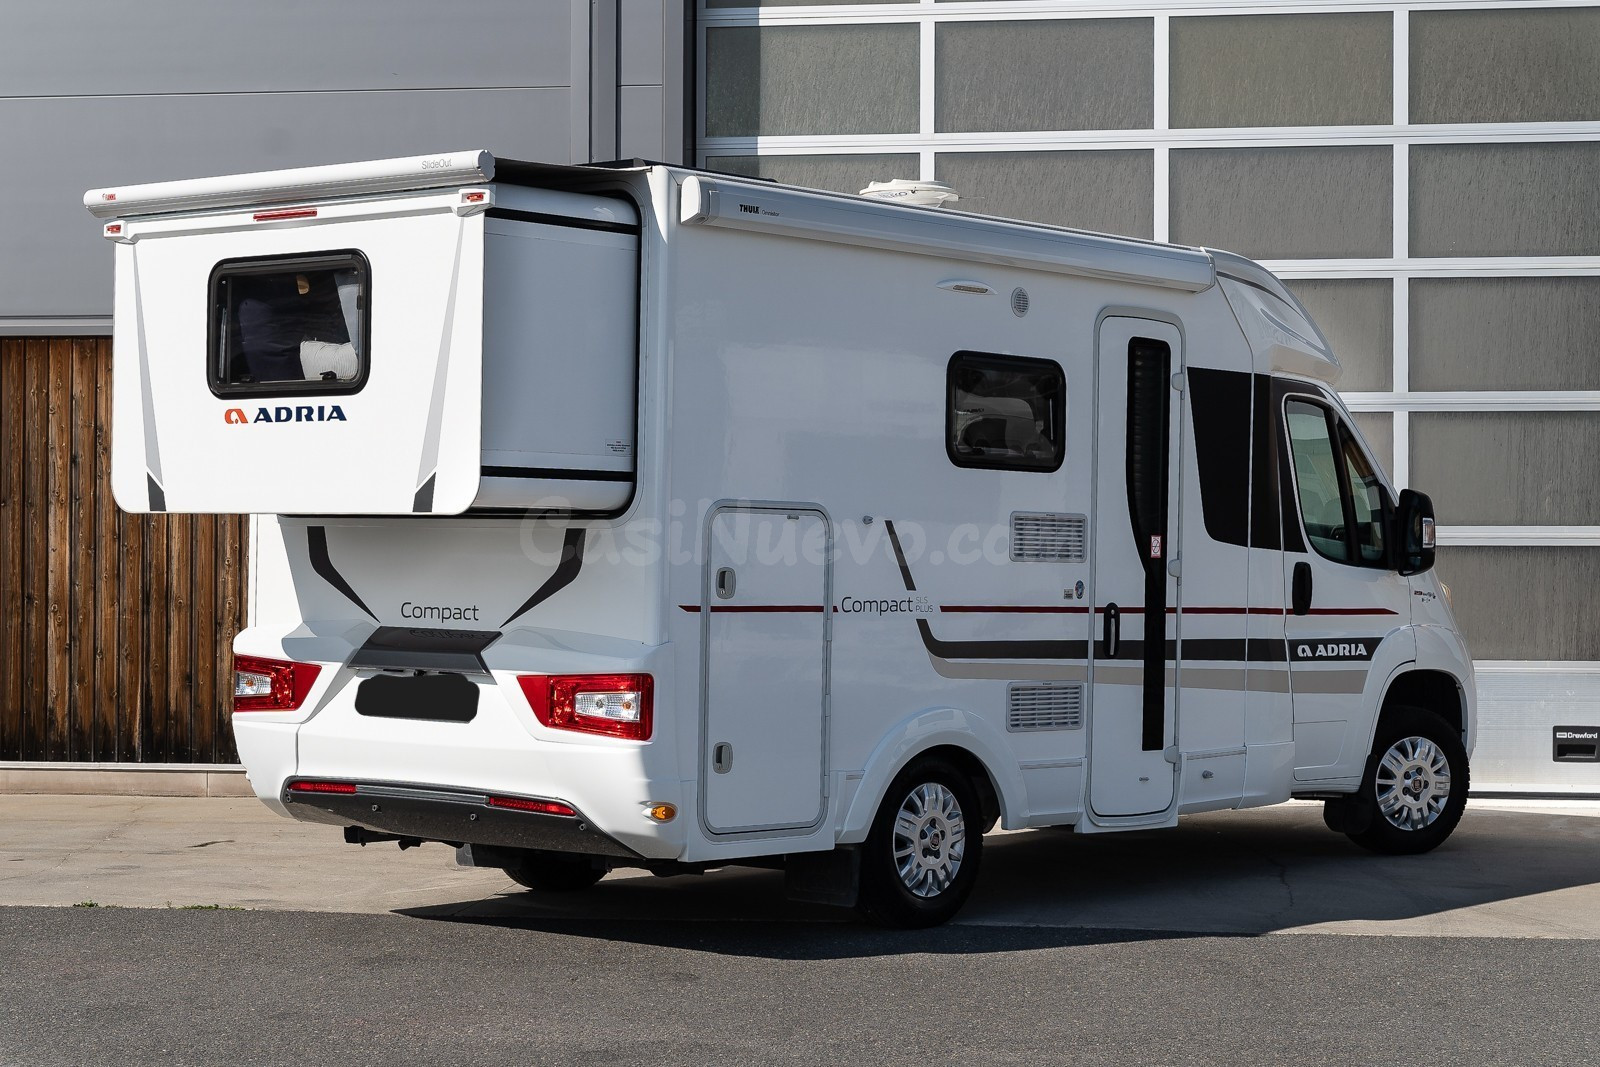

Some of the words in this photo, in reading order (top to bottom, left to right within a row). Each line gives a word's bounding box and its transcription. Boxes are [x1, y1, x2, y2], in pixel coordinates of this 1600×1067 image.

[421, 158, 452, 170] SlideOut
[739, 204, 760, 214] THULE
[253, 405, 347, 424] ADRIA
[401, 602, 479, 623] Compact
[841, 596, 913, 616] Compact
[915, 605, 933, 613] PLUS
[1315, 643, 1367, 657] ADRIA
